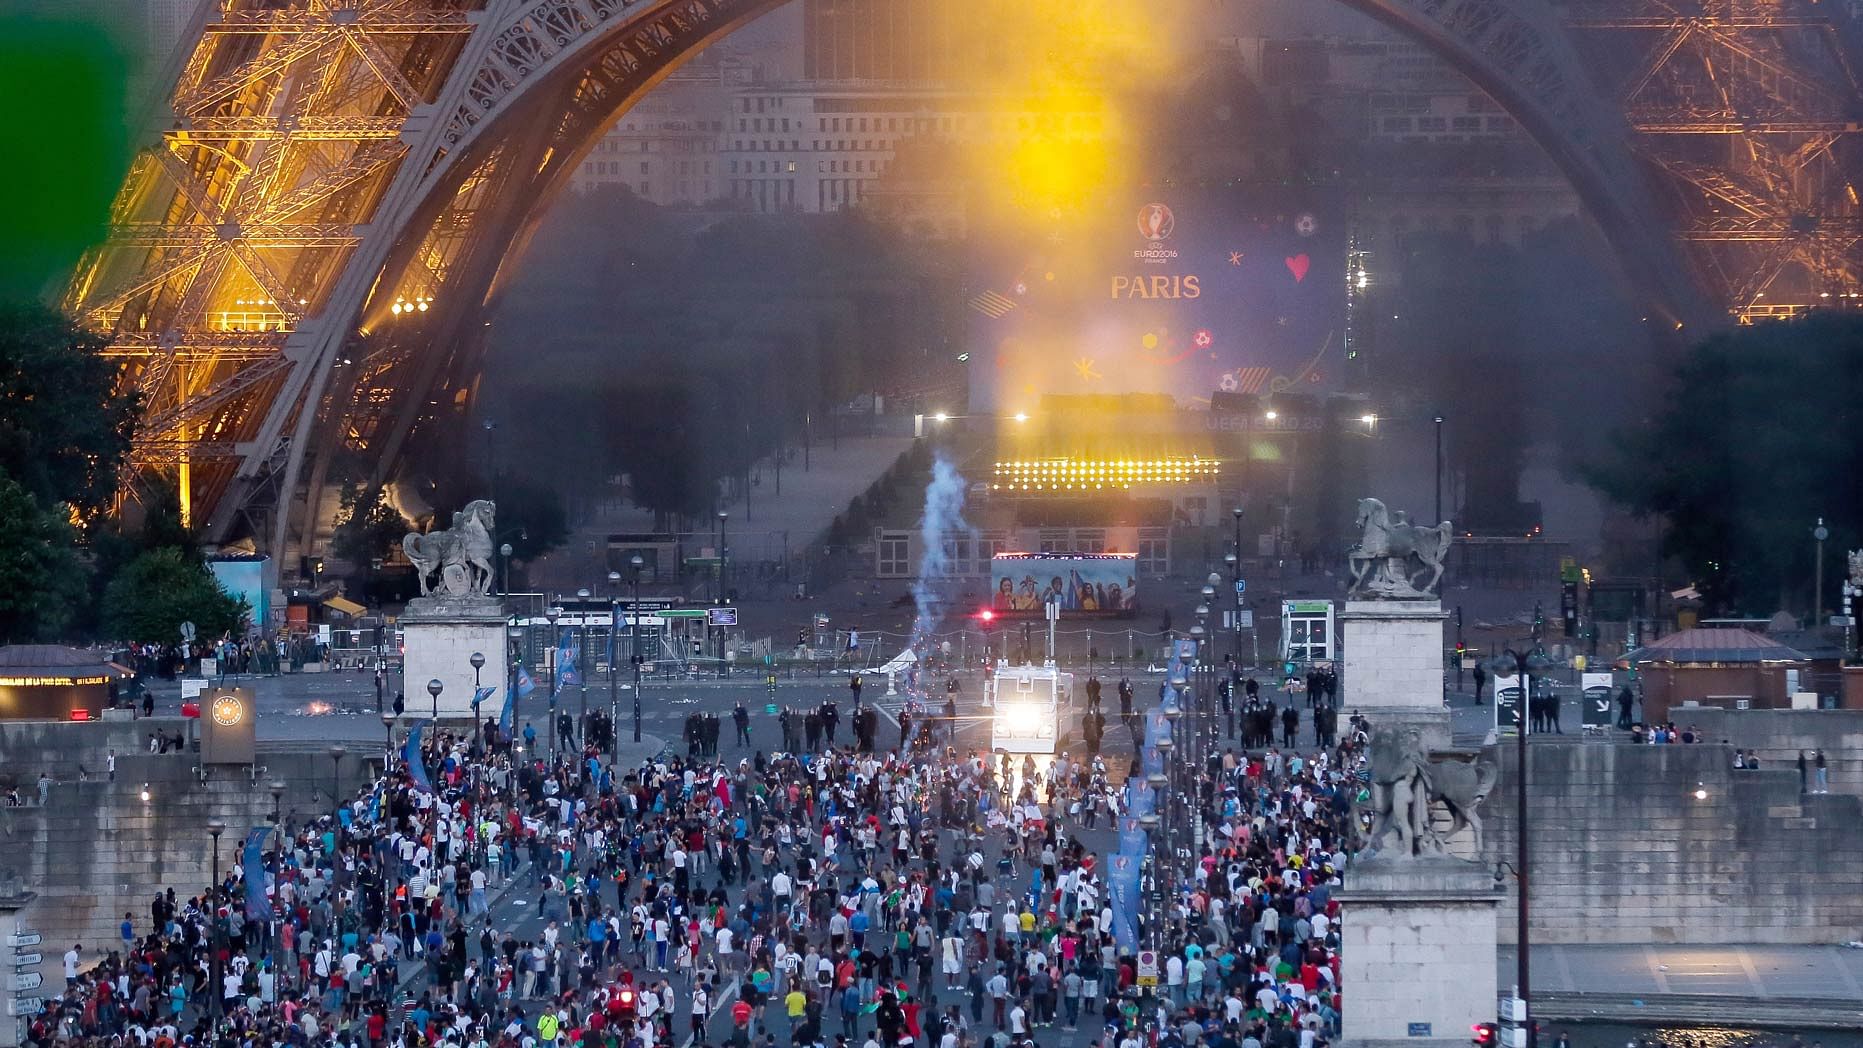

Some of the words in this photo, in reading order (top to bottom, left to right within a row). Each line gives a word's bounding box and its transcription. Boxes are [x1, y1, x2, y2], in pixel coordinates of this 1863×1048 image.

[1134, 250, 1178, 258] EURO2016
[1111, 275, 1200, 299] PARIS
[1206, 416, 1248, 431] UEFA
